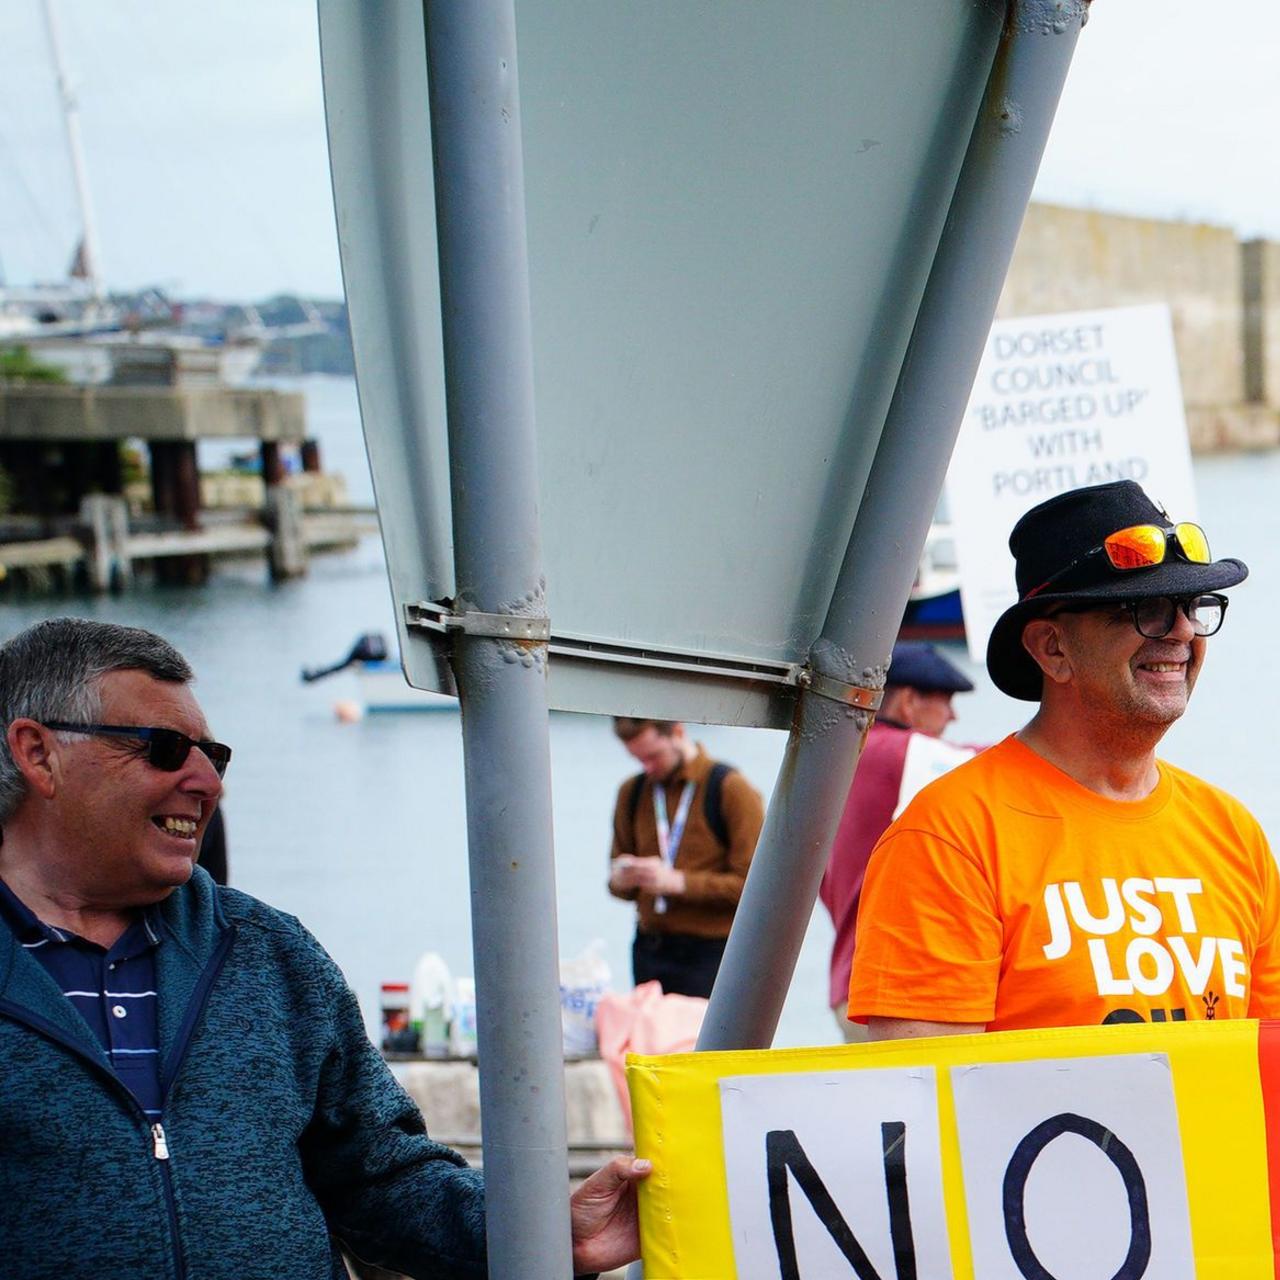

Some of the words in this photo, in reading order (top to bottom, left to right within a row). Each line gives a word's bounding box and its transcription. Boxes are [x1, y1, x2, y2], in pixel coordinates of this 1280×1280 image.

[993, 323, 1106, 360] DORSET
[990, 360, 1119, 395] COUNCIL
[1027, 428, 1103, 459] WITH
[1042, 877, 1203, 961] JUST
[1088, 936, 1246, 999] LOVE
